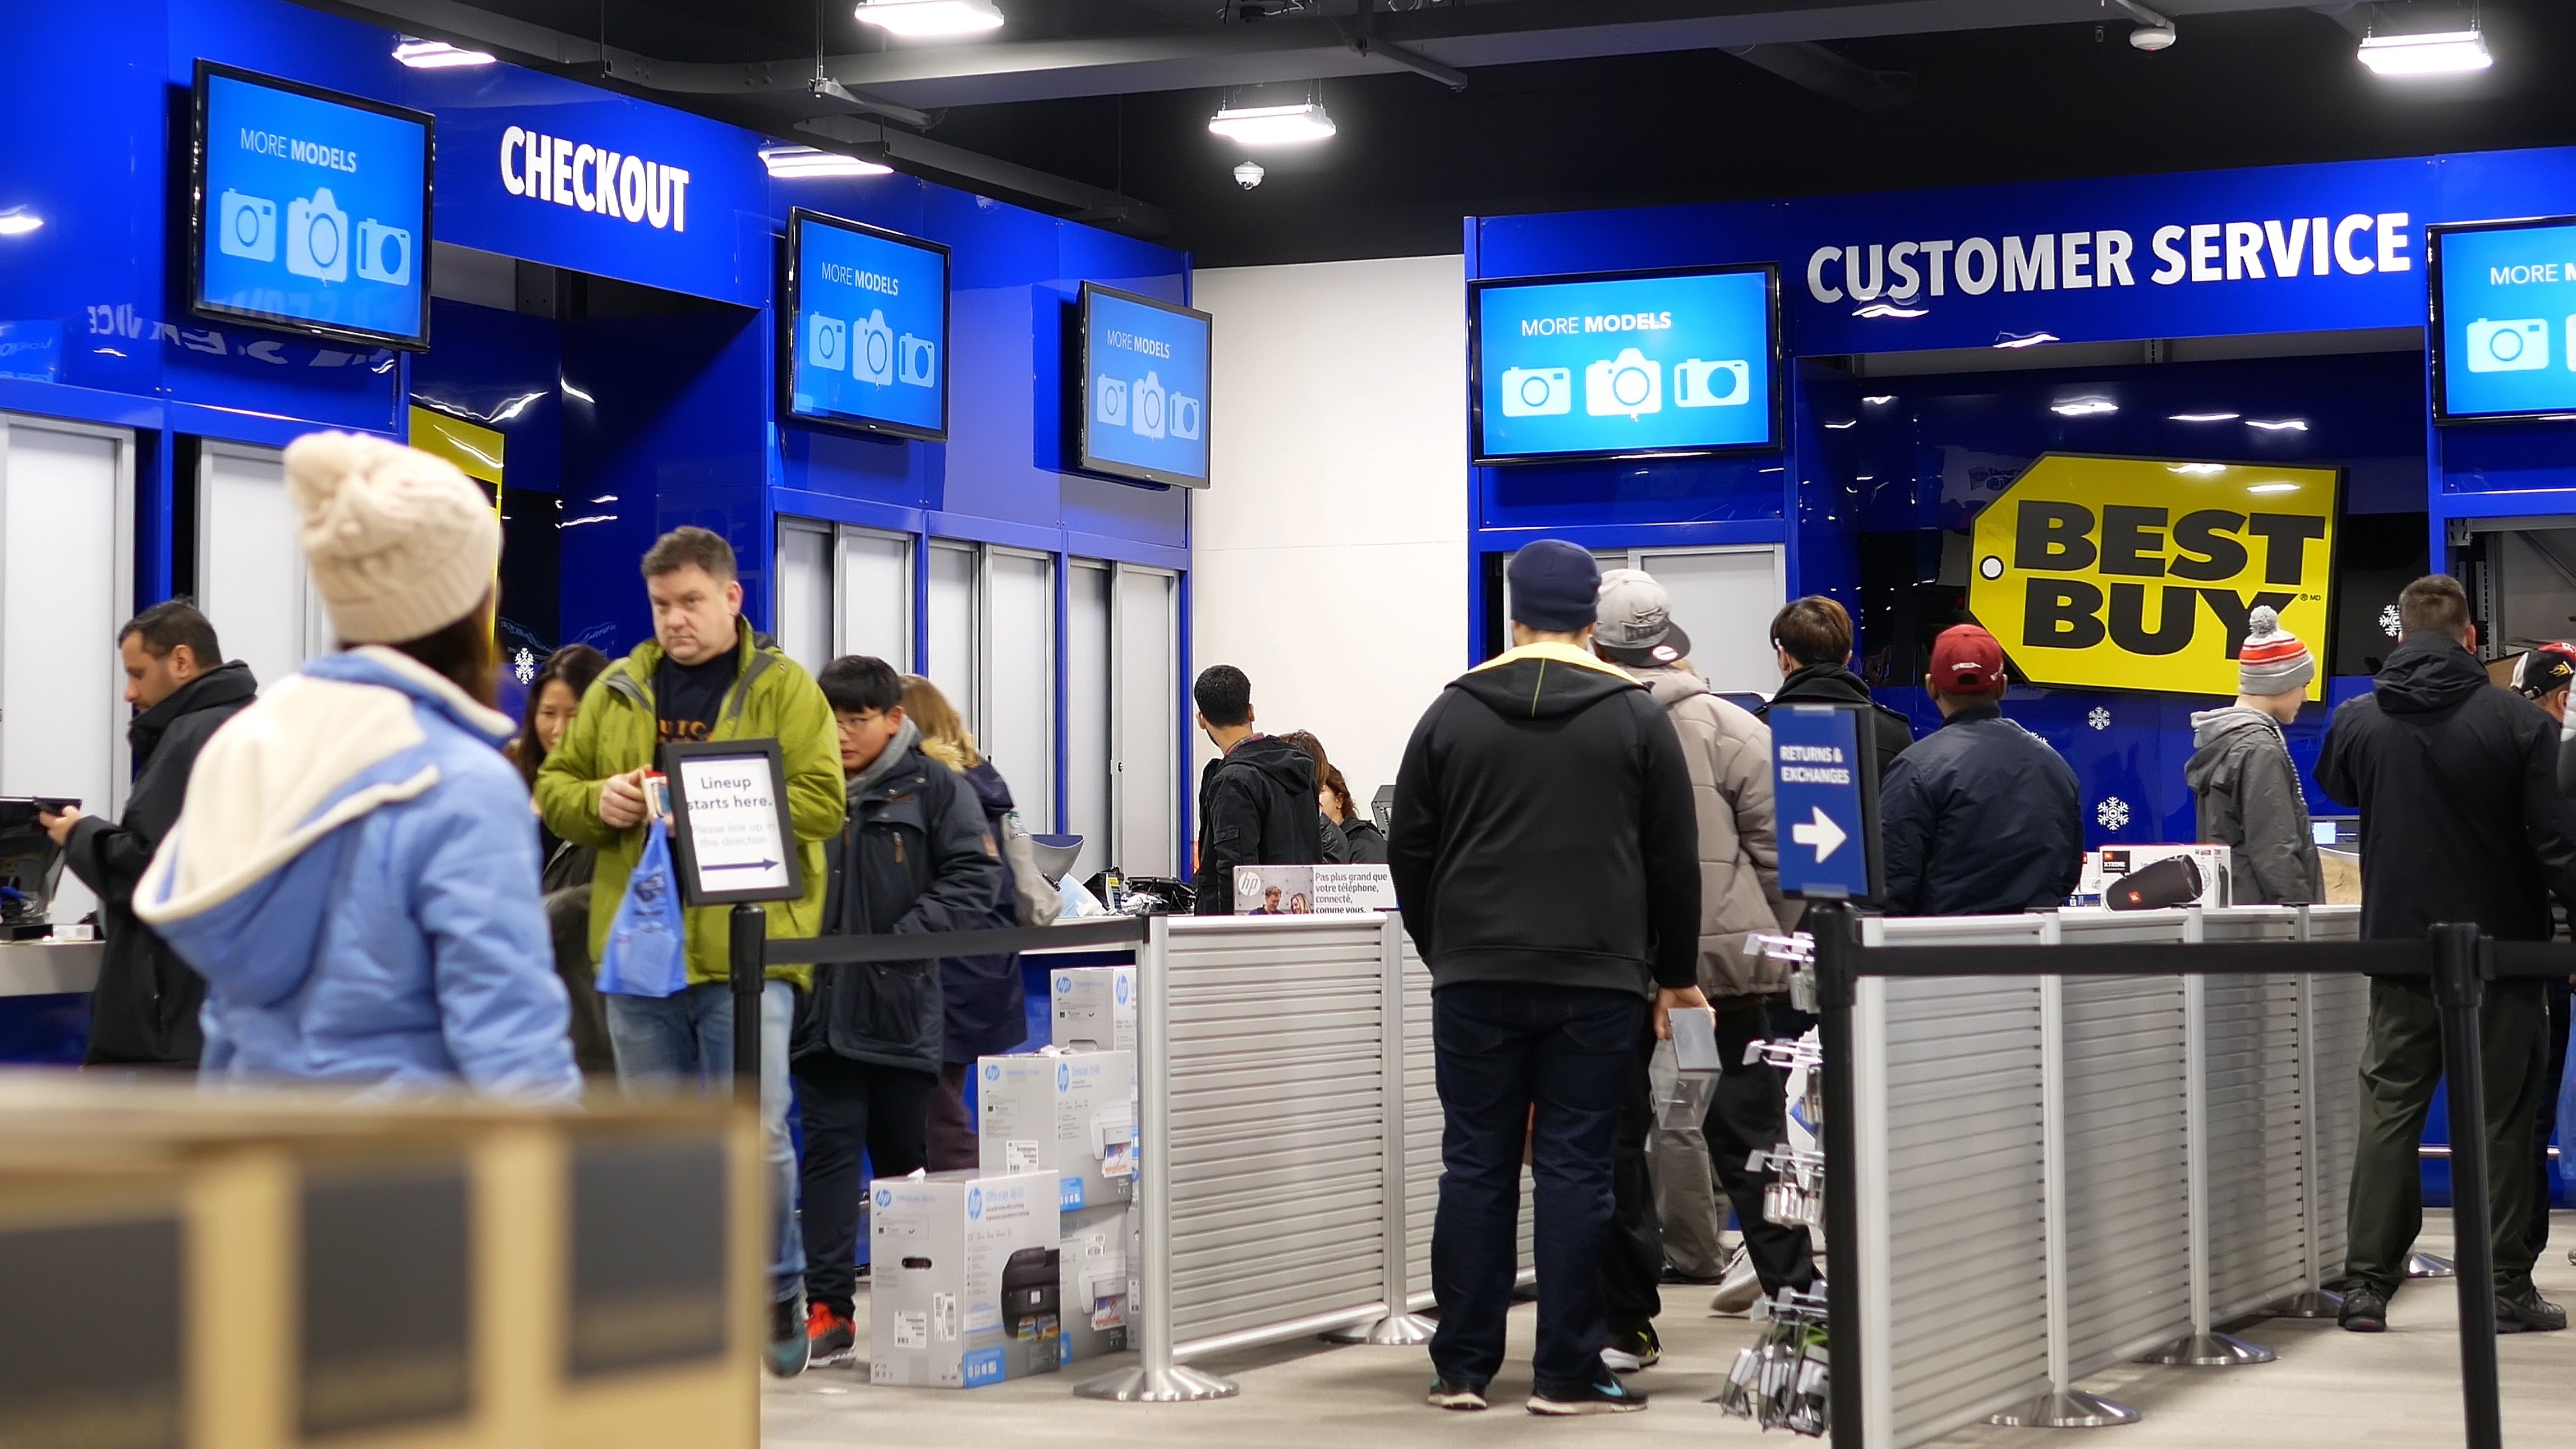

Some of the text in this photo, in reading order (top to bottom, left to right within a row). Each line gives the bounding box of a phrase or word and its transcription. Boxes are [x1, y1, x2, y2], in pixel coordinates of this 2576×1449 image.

[241, 128, 357, 173] MORE MODELS
[501, 126, 689, 232] CHECKOUT
[1807, 212, 2411, 303] CUSTOMER SERVICE
[822, 262, 899, 296] MORE MODELS
[2491, 264, 2559, 286] MORE
[1521, 311, 1671, 337] MORE MODELS
[1107, 329, 1170, 359] MORE MODELS
[2014, 499, 2327, 586] BEST
[2022, 577, 2300, 660] BUY
[1779, 746, 1843, 763] RETURNS &
[701, 776, 752, 792] Lineup
[1781, 766, 1850, 784] EXCHANGES
[687, 795, 773, 811] starts here.
[1239, 872, 1260, 896] hp
[1315, 871, 1387, 884] Pas plus grand que
[1315, 881, 1379, 894] votre téléphone,
[1315, 893, 1353, 904] connecté,
[1056, 976, 1071, 993] hp
[876, 1189, 891, 1207] hp
